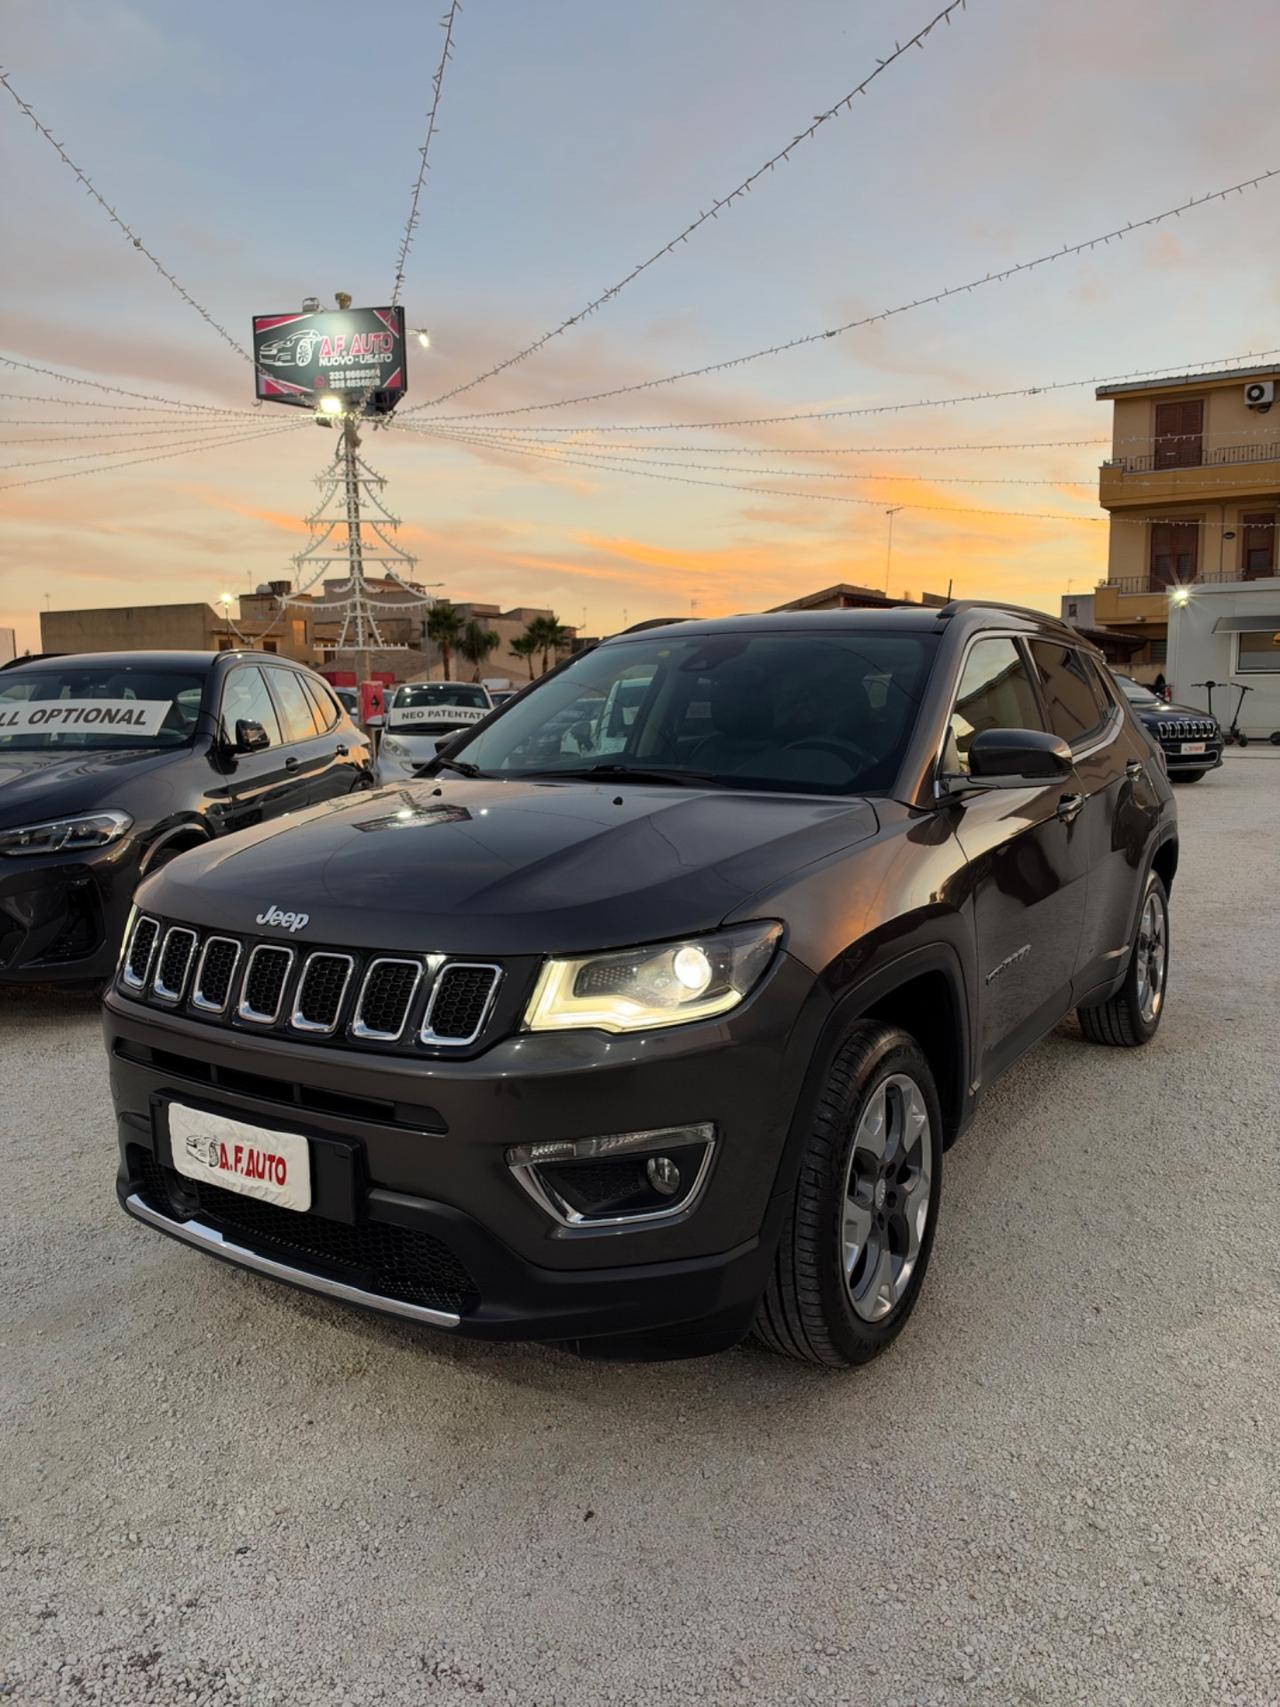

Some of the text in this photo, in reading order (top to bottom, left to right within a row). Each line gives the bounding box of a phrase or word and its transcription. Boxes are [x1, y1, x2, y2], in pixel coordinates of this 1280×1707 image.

[349, 332, 393, 355] AUTO
[28, 708, 147, 726] OPTIONAL
[401, 711, 425, 720] NEO
[256, 905, 309, 933] Jeep
